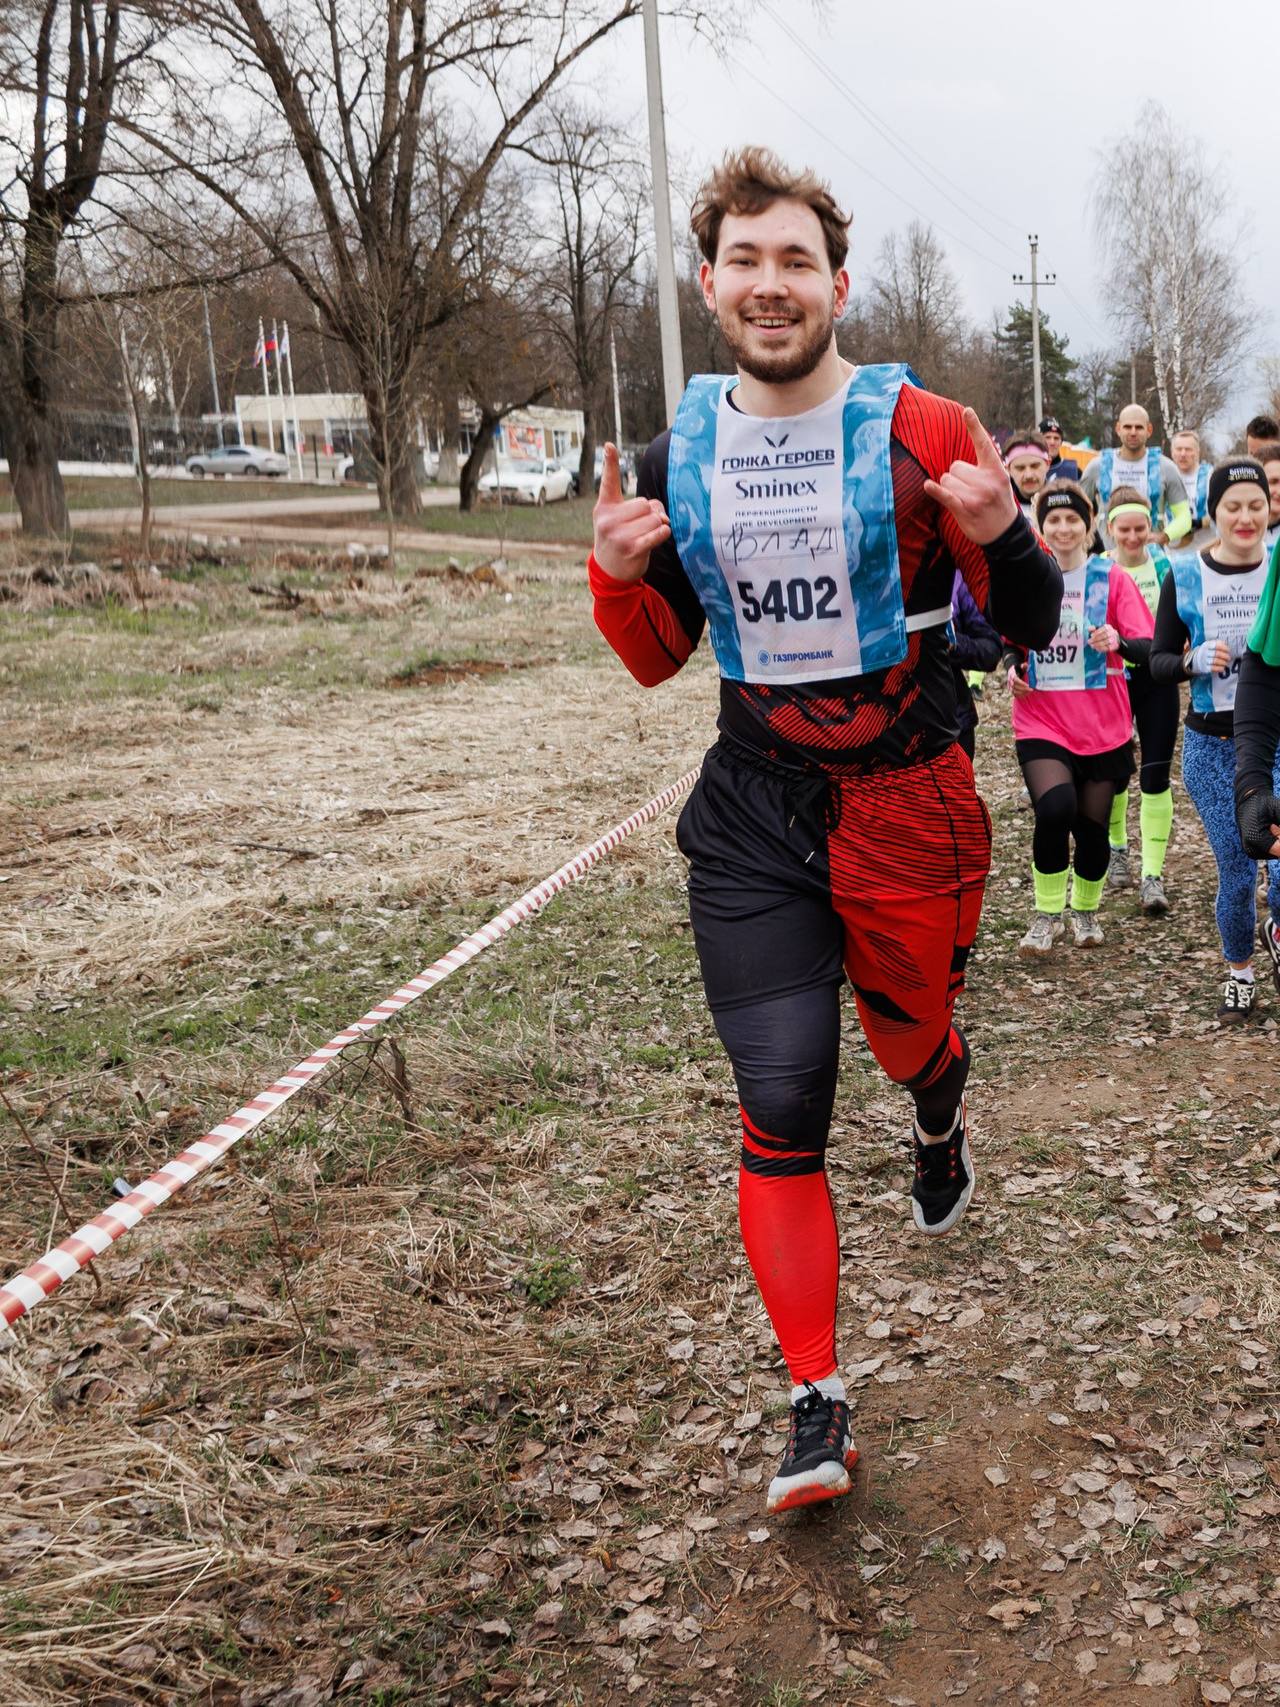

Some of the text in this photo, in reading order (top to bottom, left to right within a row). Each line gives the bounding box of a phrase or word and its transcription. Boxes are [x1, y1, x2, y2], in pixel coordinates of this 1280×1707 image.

[722, 449, 835, 470] ГОНКА ГЕРОЕВ
[735, 478, 817, 500] Sminex
[735, 505, 818, 517] ПЕРФЕКЦИОНИСТЫ
[757, 516, 817, 527] DEVELOPMENT
[737, 576, 842, 623] 5402
[1236, 594, 1261, 602] ГЕРО
[773, 650, 834, 662] ГАЗПРОМБАНК
